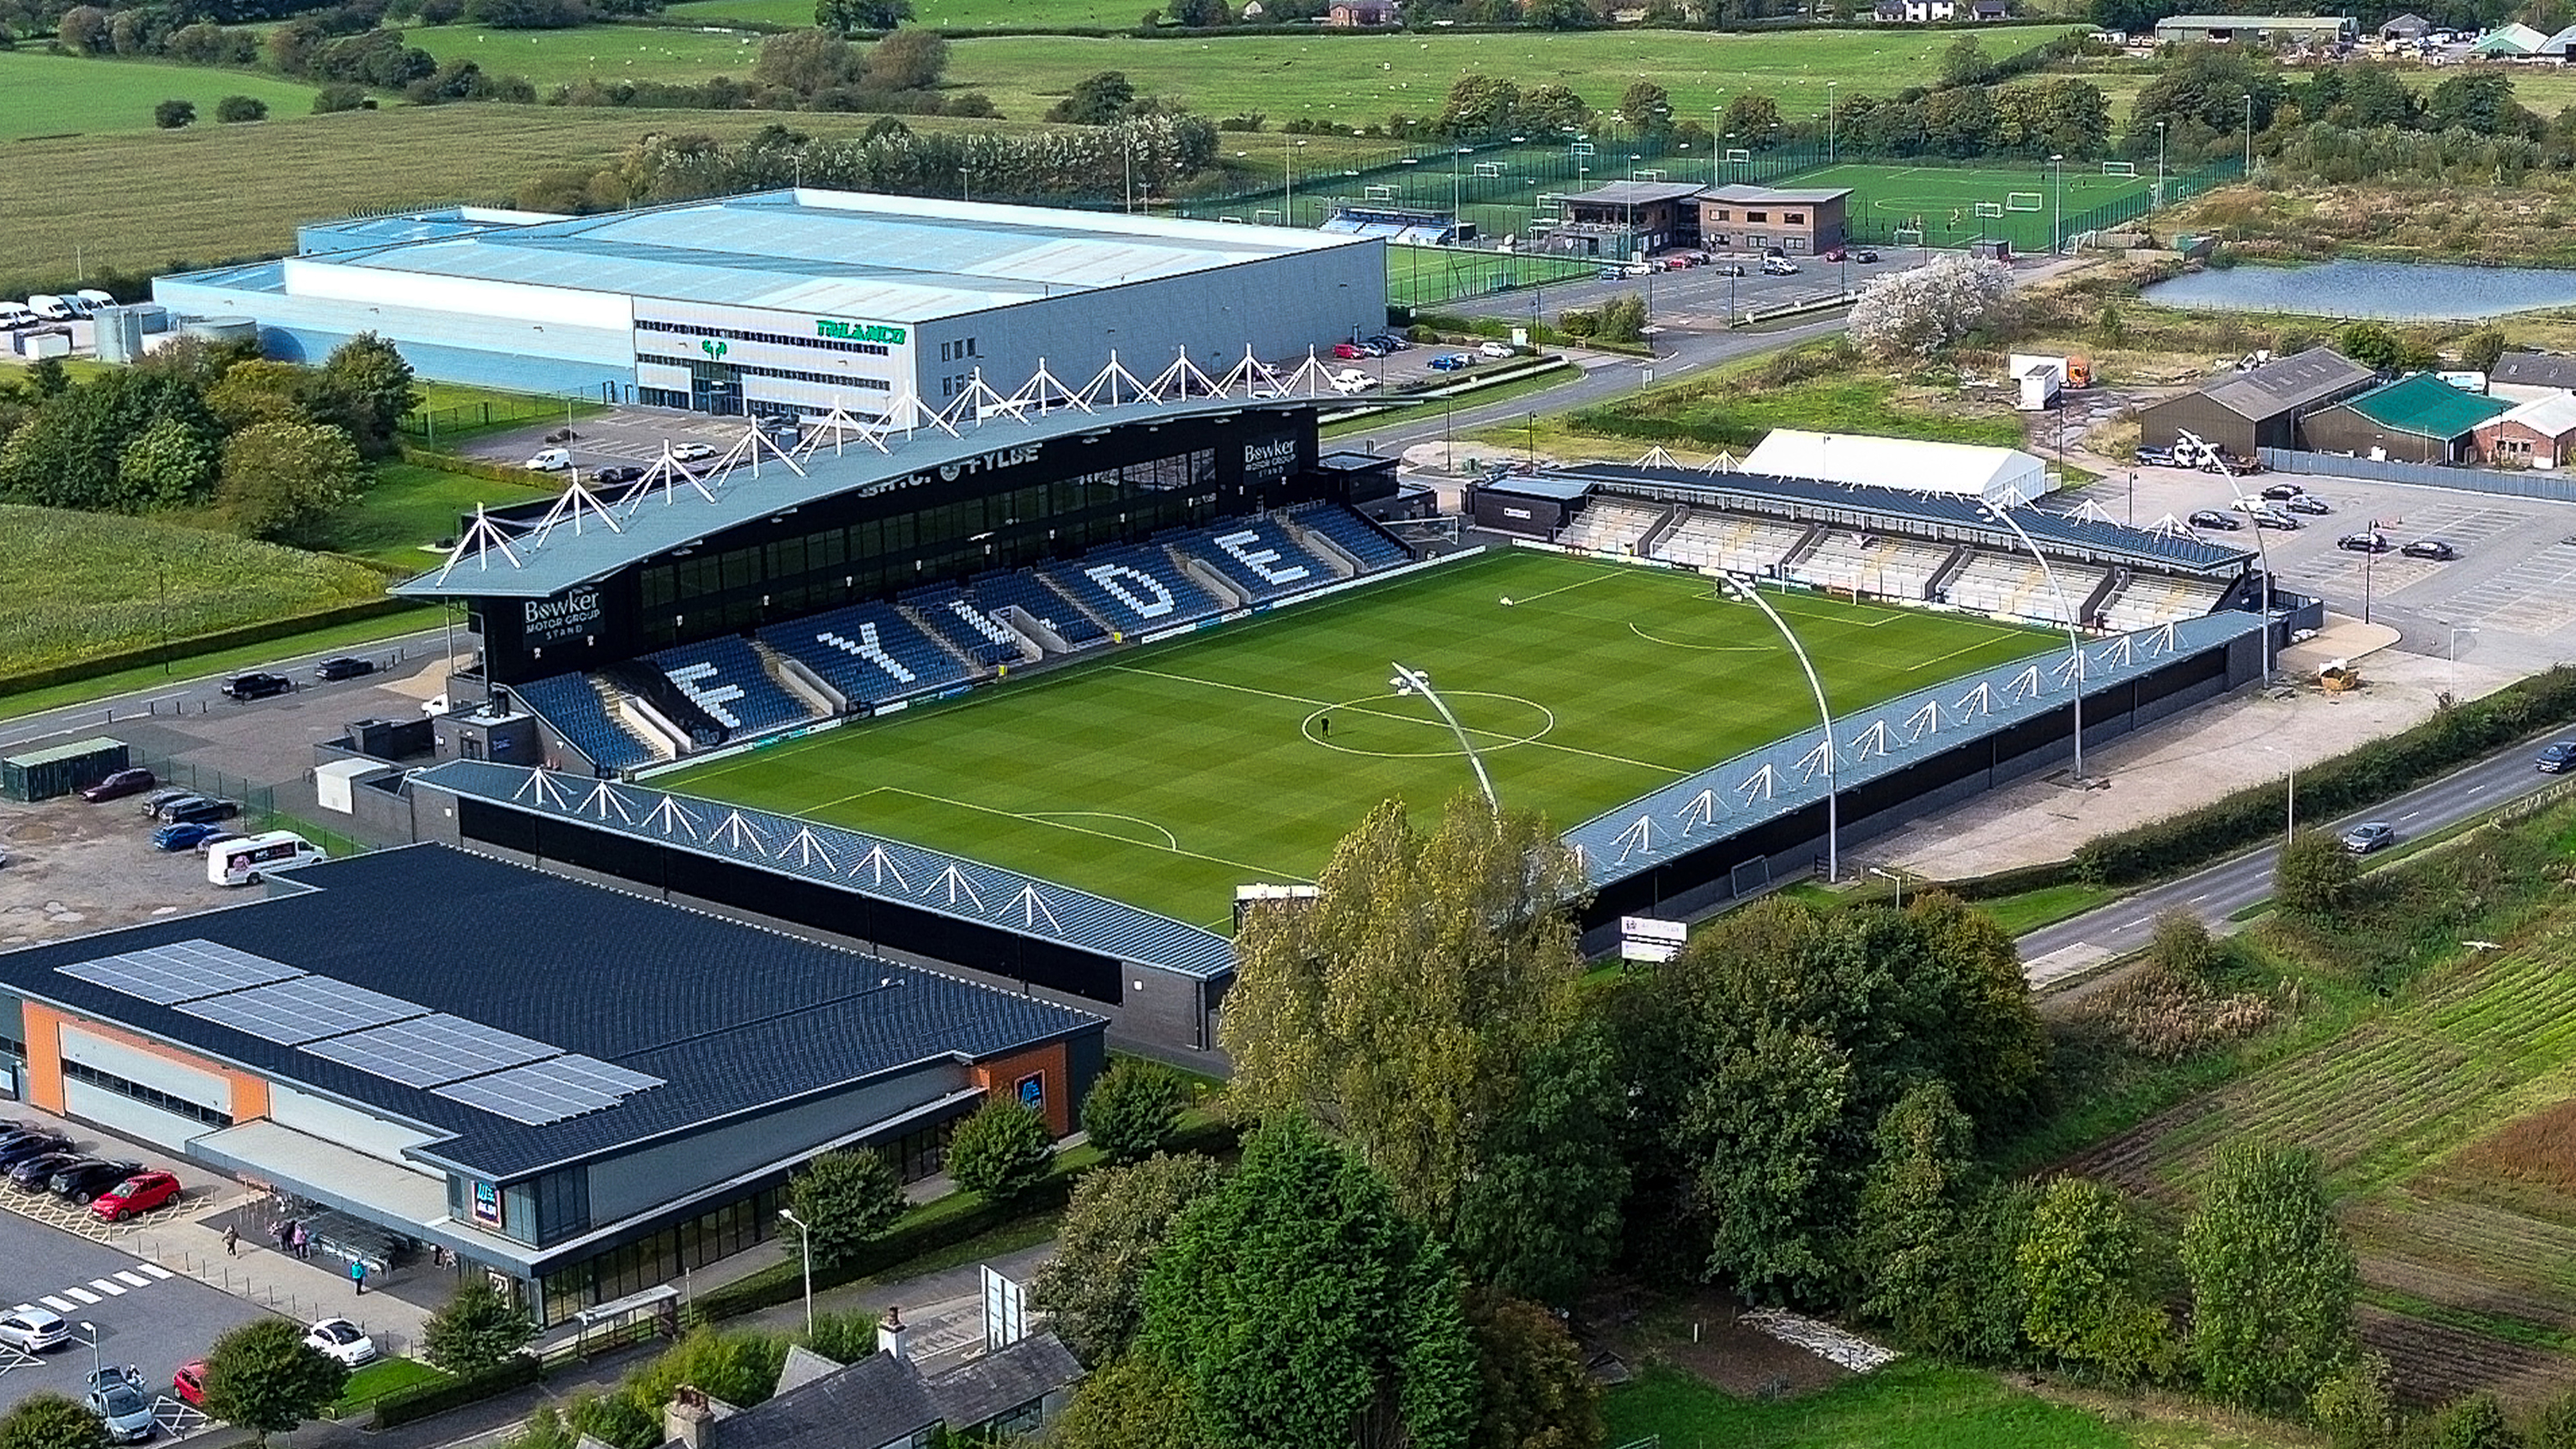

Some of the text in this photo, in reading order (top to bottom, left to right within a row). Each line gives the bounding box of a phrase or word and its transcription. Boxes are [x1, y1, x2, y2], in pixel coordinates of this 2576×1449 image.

[1244, 438, 1297, 463] Bowker
[525, 591, 599, 623] Bowker
[526, 609, 601, 634] MOTOR GROUP
[545, 624, 583, 641] STAND
